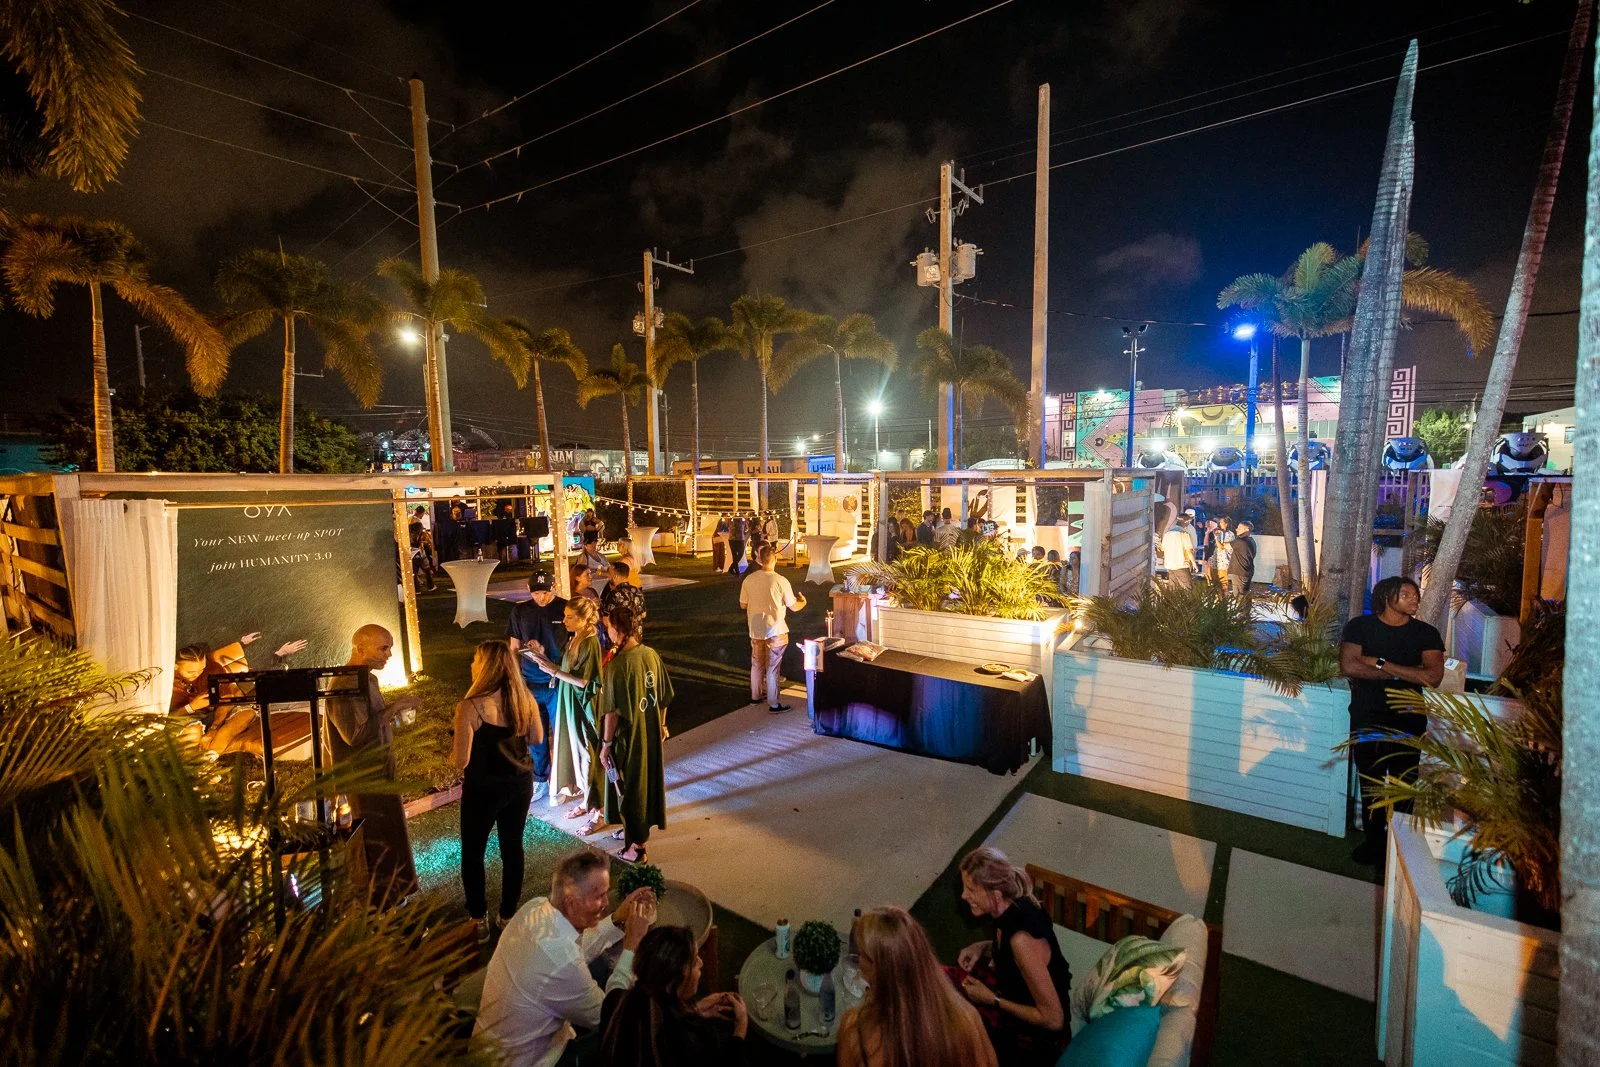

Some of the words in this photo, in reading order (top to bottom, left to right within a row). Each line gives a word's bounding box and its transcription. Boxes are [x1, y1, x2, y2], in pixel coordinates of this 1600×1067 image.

[194, 538, 224, 547] Your
[228, 534, 260, 544] NEW
[264, 531, 310, 542] meet-up
[313, 527, 344, 538] SPOT
[207, 561, 236, 574] join
[240, 553, 311, 568] HUMANITY
[314, 551, 332, 561] 3.0
